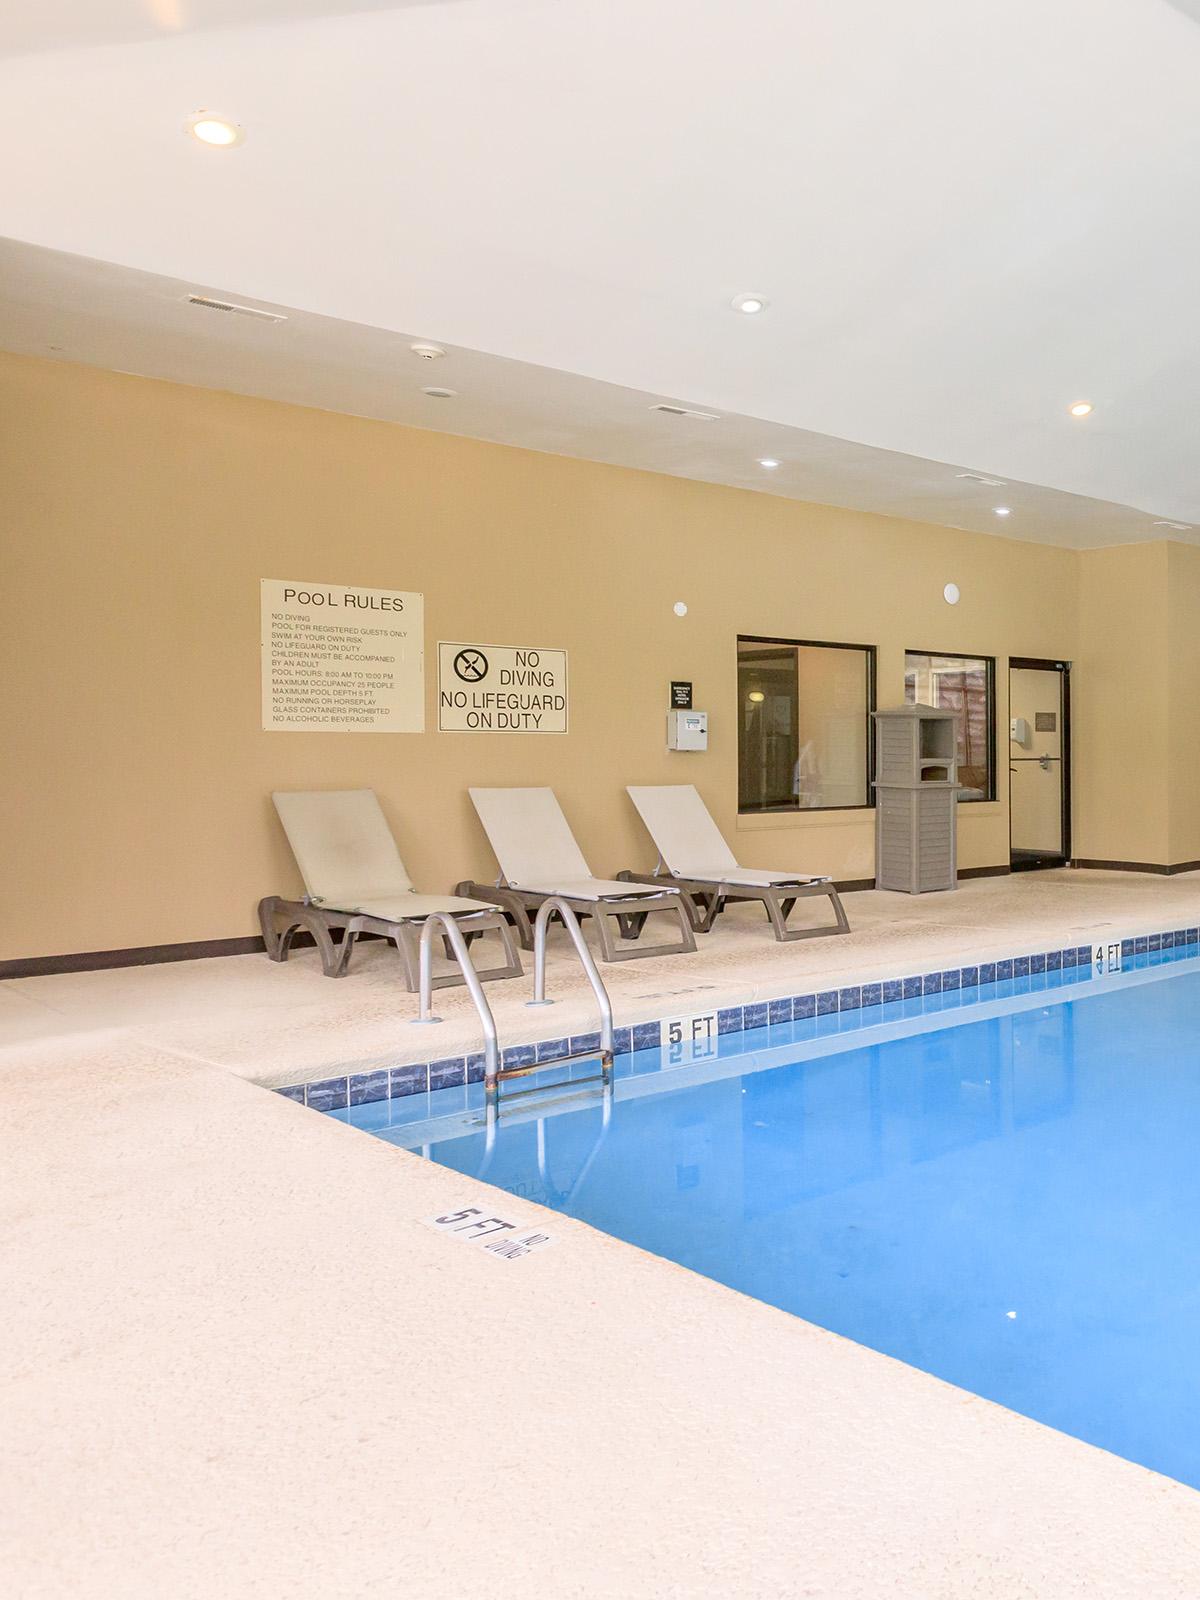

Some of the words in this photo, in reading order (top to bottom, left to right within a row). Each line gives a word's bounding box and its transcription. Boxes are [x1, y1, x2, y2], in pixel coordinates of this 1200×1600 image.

[283, 588, 338, 606] POOL
[344, 593, 403, 612] RULES
[284, 614, 310, 622] DIVING
[271, 621, 293, 630] POOL
[295, 623, 312, 631] FOR
[312, 624, 358, 634] REGISTERED
[359, 627, 388, 636] GUESTS
[389, 629, 407, 637] ONLY
[284, 641, 326, 650] LIFEGUARD
[271, 650, 309, 658] CHILDREN
[344, 654, 395, 662] ACCOMPANIED
[515, 650, 539, 667] NO
[310, 679, 355, 687] OCCUPANCY
[366, 681, 393, 689] PEOPLE
[500, 669, 554, 686] DIVING
[441, 691, 467, 707] NO
[472, 692, 564, 710] LIFEGUARD
[466, 711, 491, 727] ON
[497, 712, 541, 728] DUTY
[1096, 946, 1103, 961] 4
[1108, 944, 1120, 960] FT
[669, 1022, 682, 1044] 5
[692, 1016, 714, 1040] FT
[435, 1208, 482, 1224] 5
[454, 1218, 516, 1239] FT
[519, 1233, 549, 1246] NO
[484, 1238, 532, 1259] DIVING
